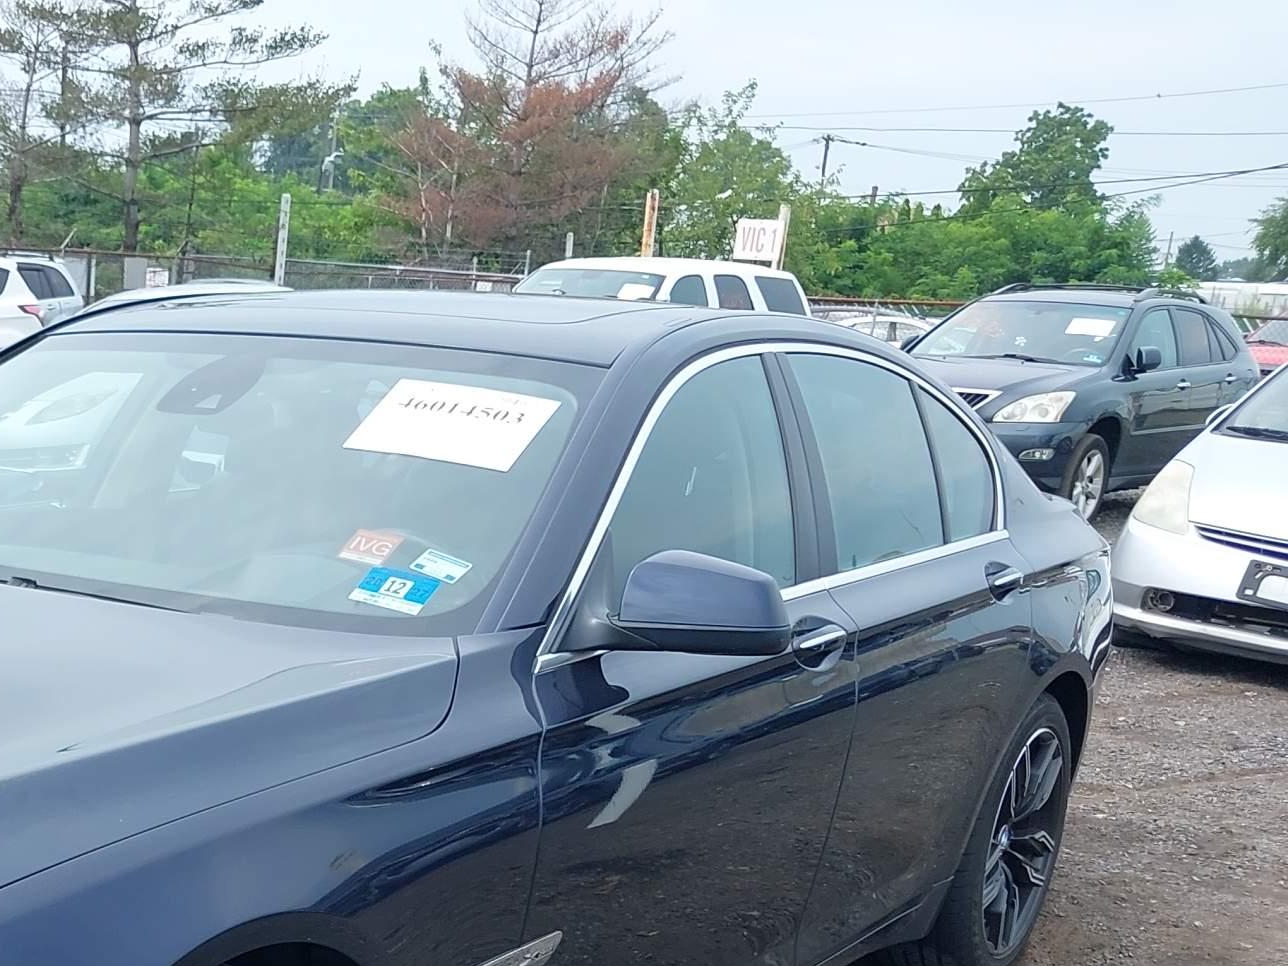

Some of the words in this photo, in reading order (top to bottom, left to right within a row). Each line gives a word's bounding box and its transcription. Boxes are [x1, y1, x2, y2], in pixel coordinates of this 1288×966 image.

[742, 226, 766, 253] VIC
[771, 226, 778, 254] 1
[398, 397, 525, 424] 46014503
[349, 535, 393, 556] IVG
[383, 580, 407, 595] 12
